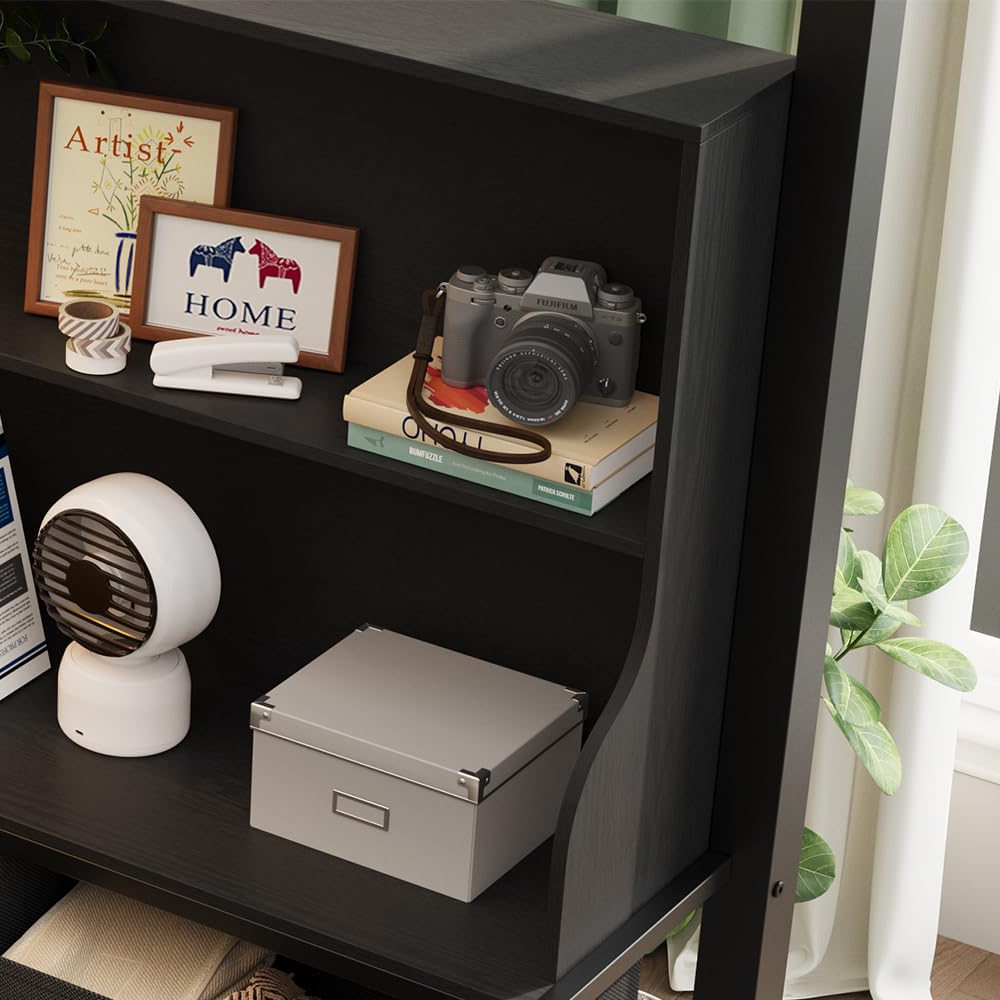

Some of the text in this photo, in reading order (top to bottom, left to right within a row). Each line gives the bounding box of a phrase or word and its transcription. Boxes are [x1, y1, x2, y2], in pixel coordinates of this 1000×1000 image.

[63, 125, 167, 165] Artist
[184, 292, 297, 331] HOME
[536, 298, 578, 311] FUJIFILM
[409, 446, 443, 464] BUMFUZZLE
[537, 484, 556, 496] PATRICK
